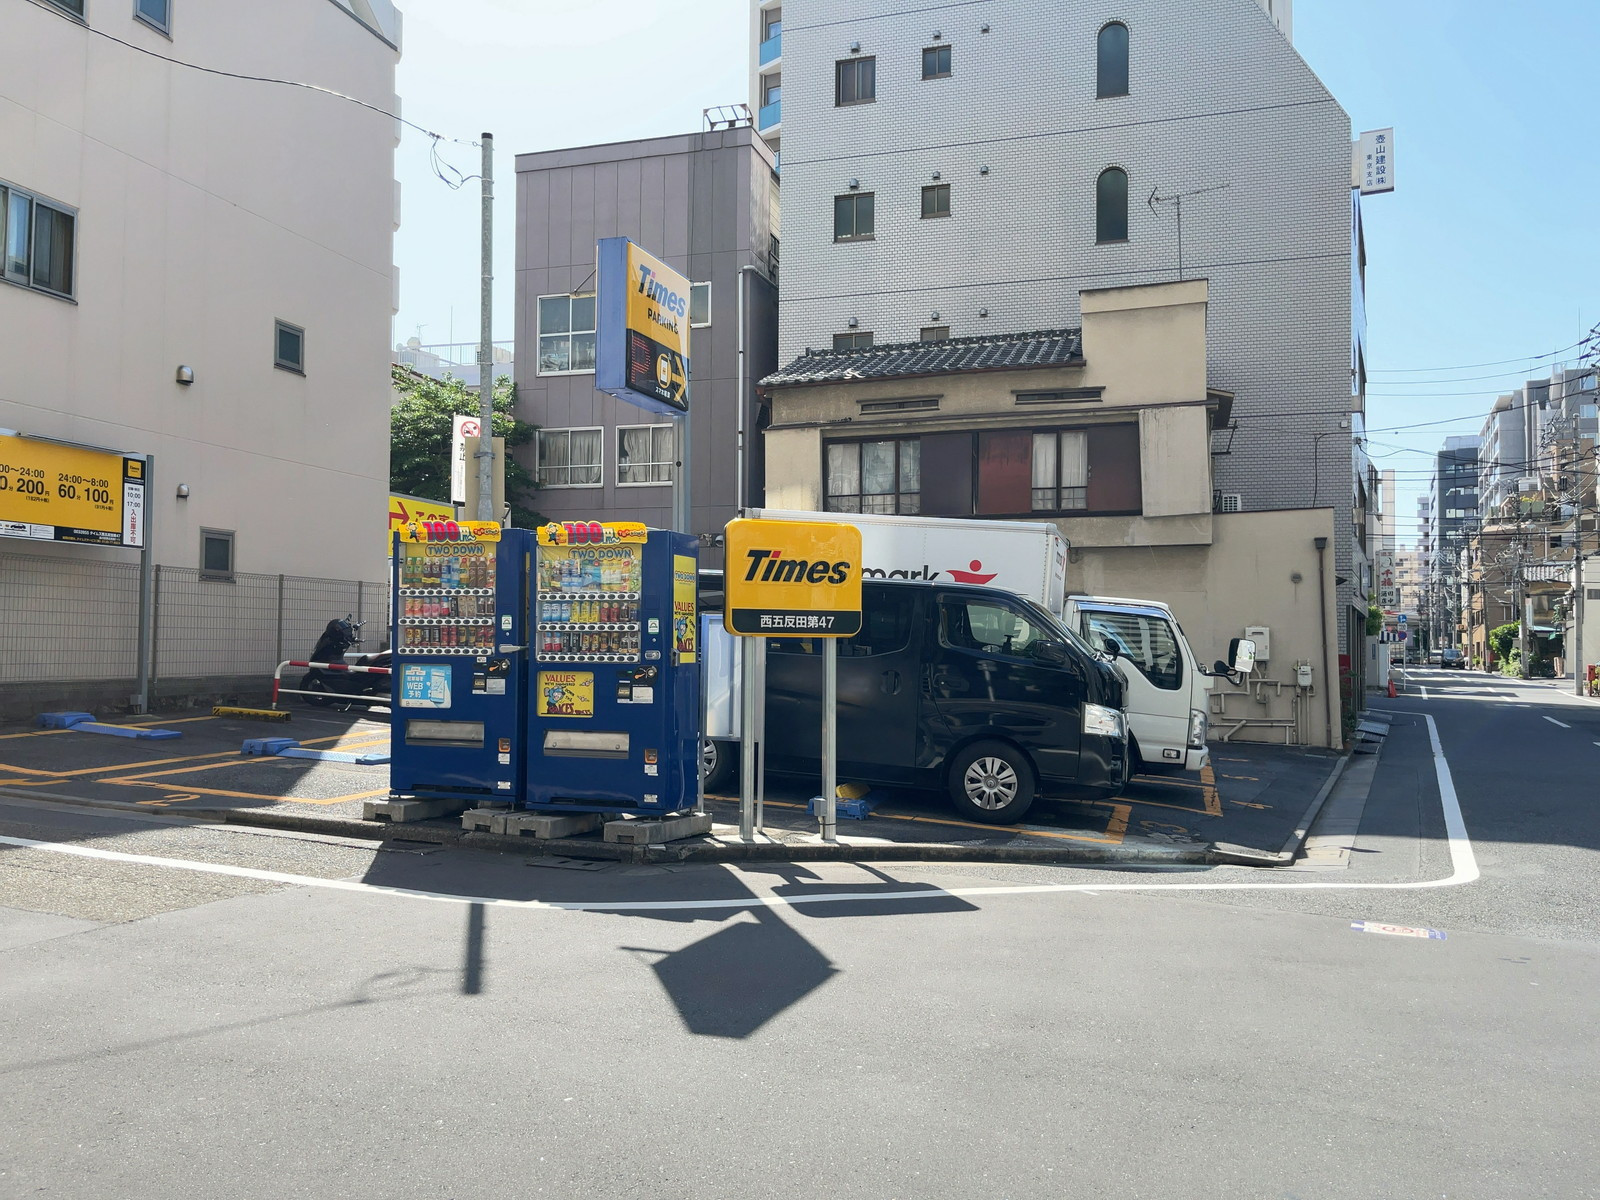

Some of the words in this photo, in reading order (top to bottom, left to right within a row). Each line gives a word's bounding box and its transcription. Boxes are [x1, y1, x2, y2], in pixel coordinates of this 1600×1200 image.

[638, 264, 686, 317] Times
[648, 308, 679, 334] PARKING
[428, 546, 450, 555] TWO
[453, 545, 483, 555] DOWN
[571, 550, 595, 559] TWO
[598, 549, 632, 559] DOWN
[745, 550, 851, 584] Times
[675, 601, 694, 612] VALUES
[760, 614, 835, 628] 西五反田第47
[545, 674, 576, 682] VALUES
[407, 682, 423, 690] WEB
